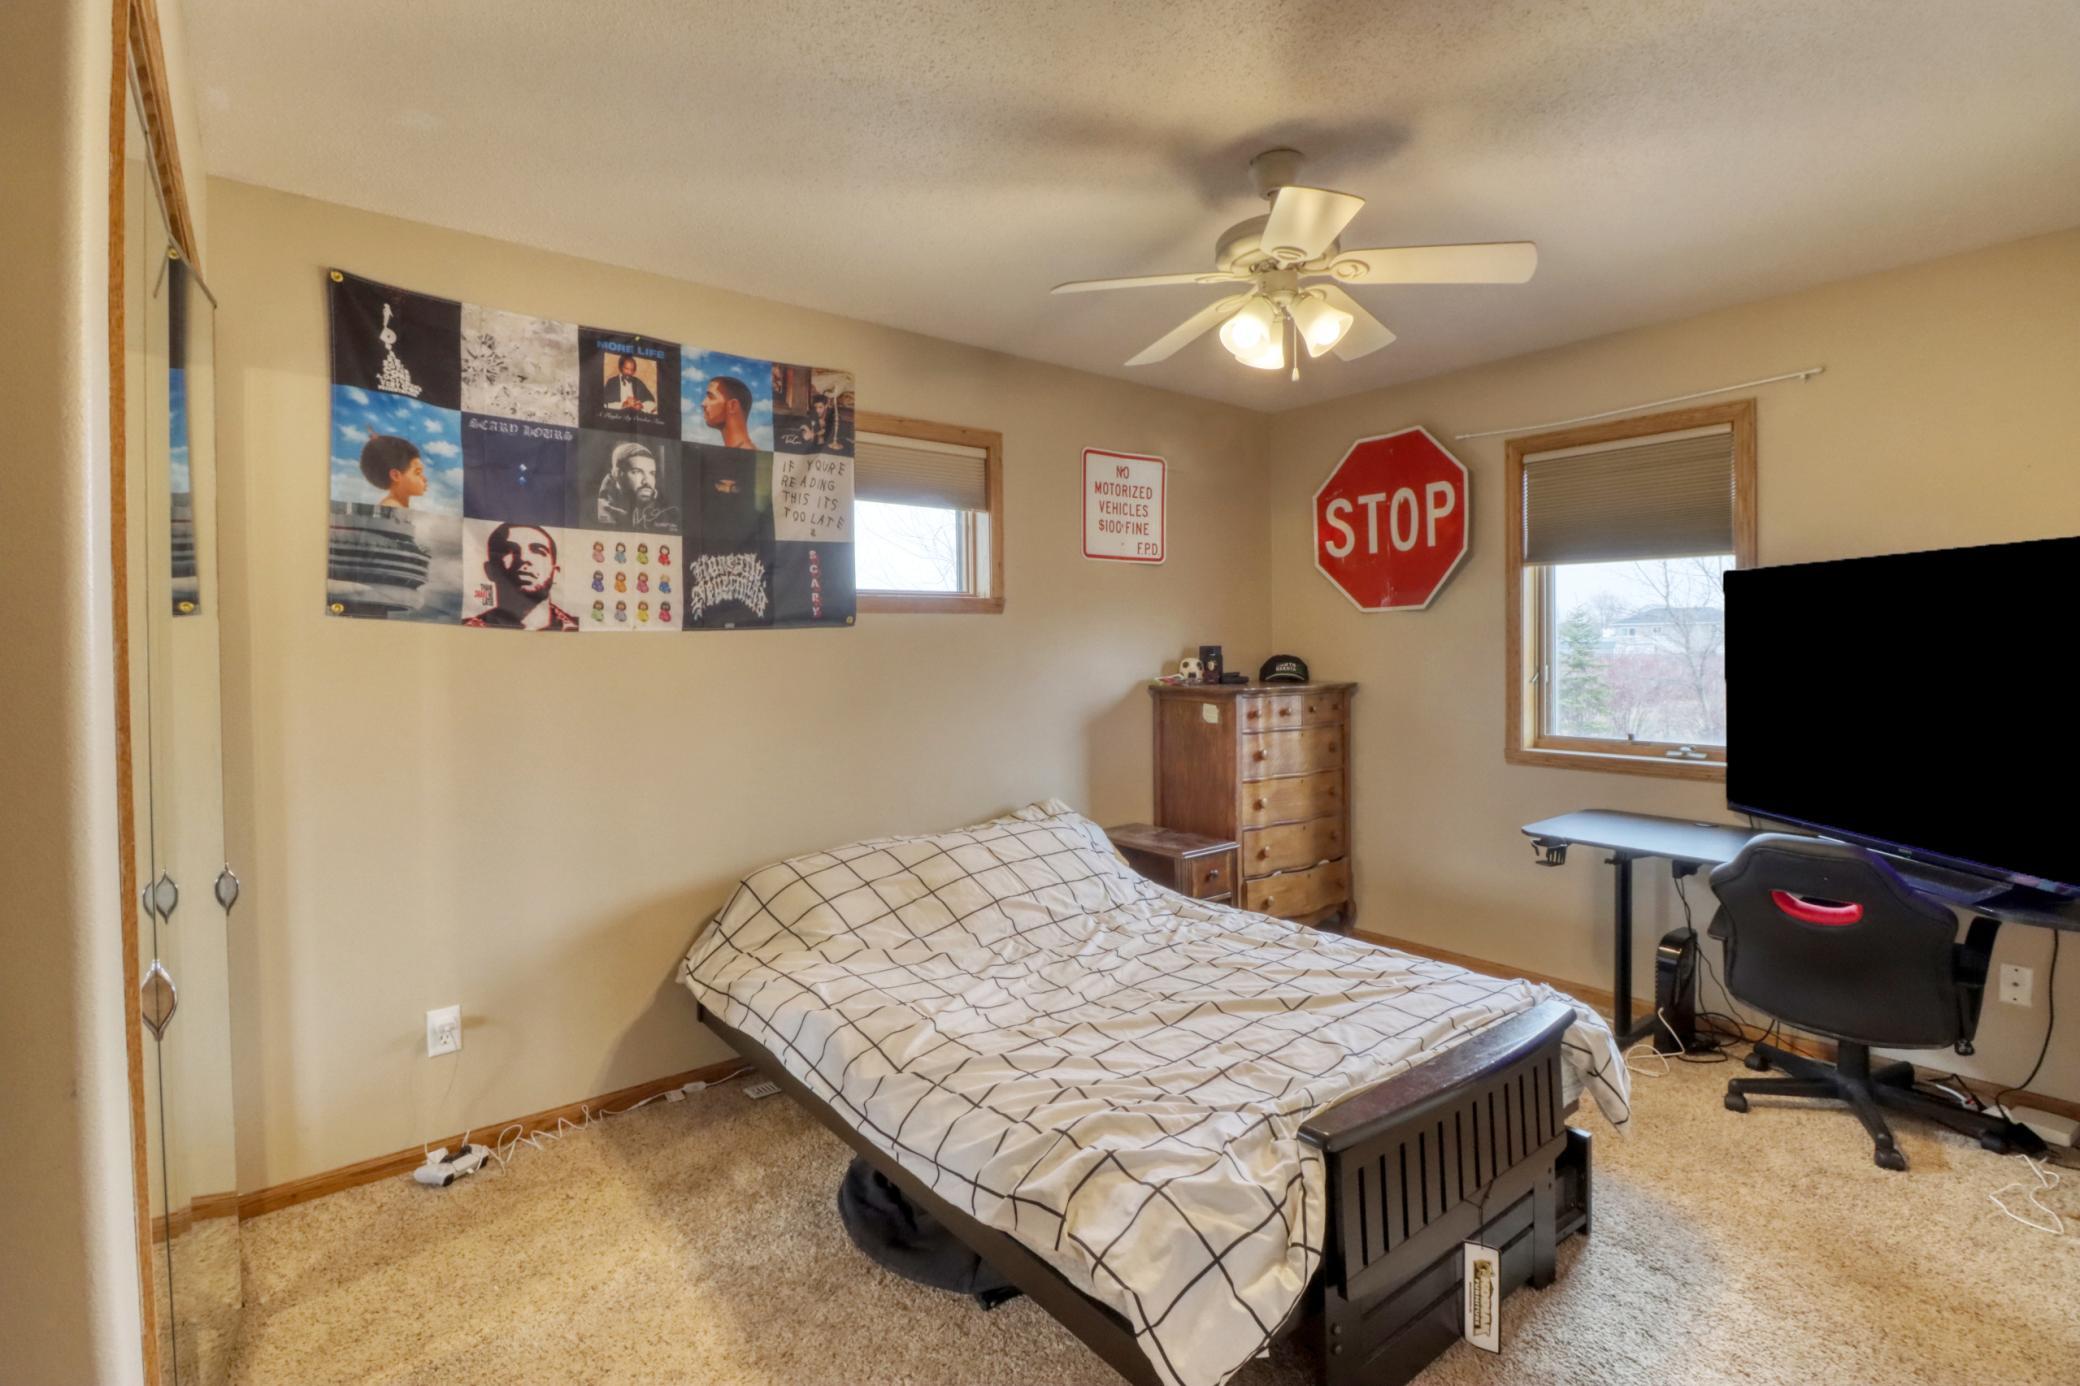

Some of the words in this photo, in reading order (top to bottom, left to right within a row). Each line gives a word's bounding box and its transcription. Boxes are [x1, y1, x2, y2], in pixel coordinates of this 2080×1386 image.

[597, 340, 634, 353] MORE
[637, 346, 665, 359] LIFE
[782, 460, 794, 473] IF
[807, 459, 846, 476] YOURE
[1116, 465, 1130, 479] NO
[781, 475, 836, 491] READING
[1094, 481, 1153, 500] MOTORIZED
[782, 490, 810, 506] THIS
[817, 496, 839, 511] ITS
[1099, 500, 1149, 518] VEHICLES
[784, 506, 806, 522] TOO
[810, 514, 846, 530] LATE
[1325, 480, 1456, 558] STOP
[1125, 521, 1150, 536] FINE
